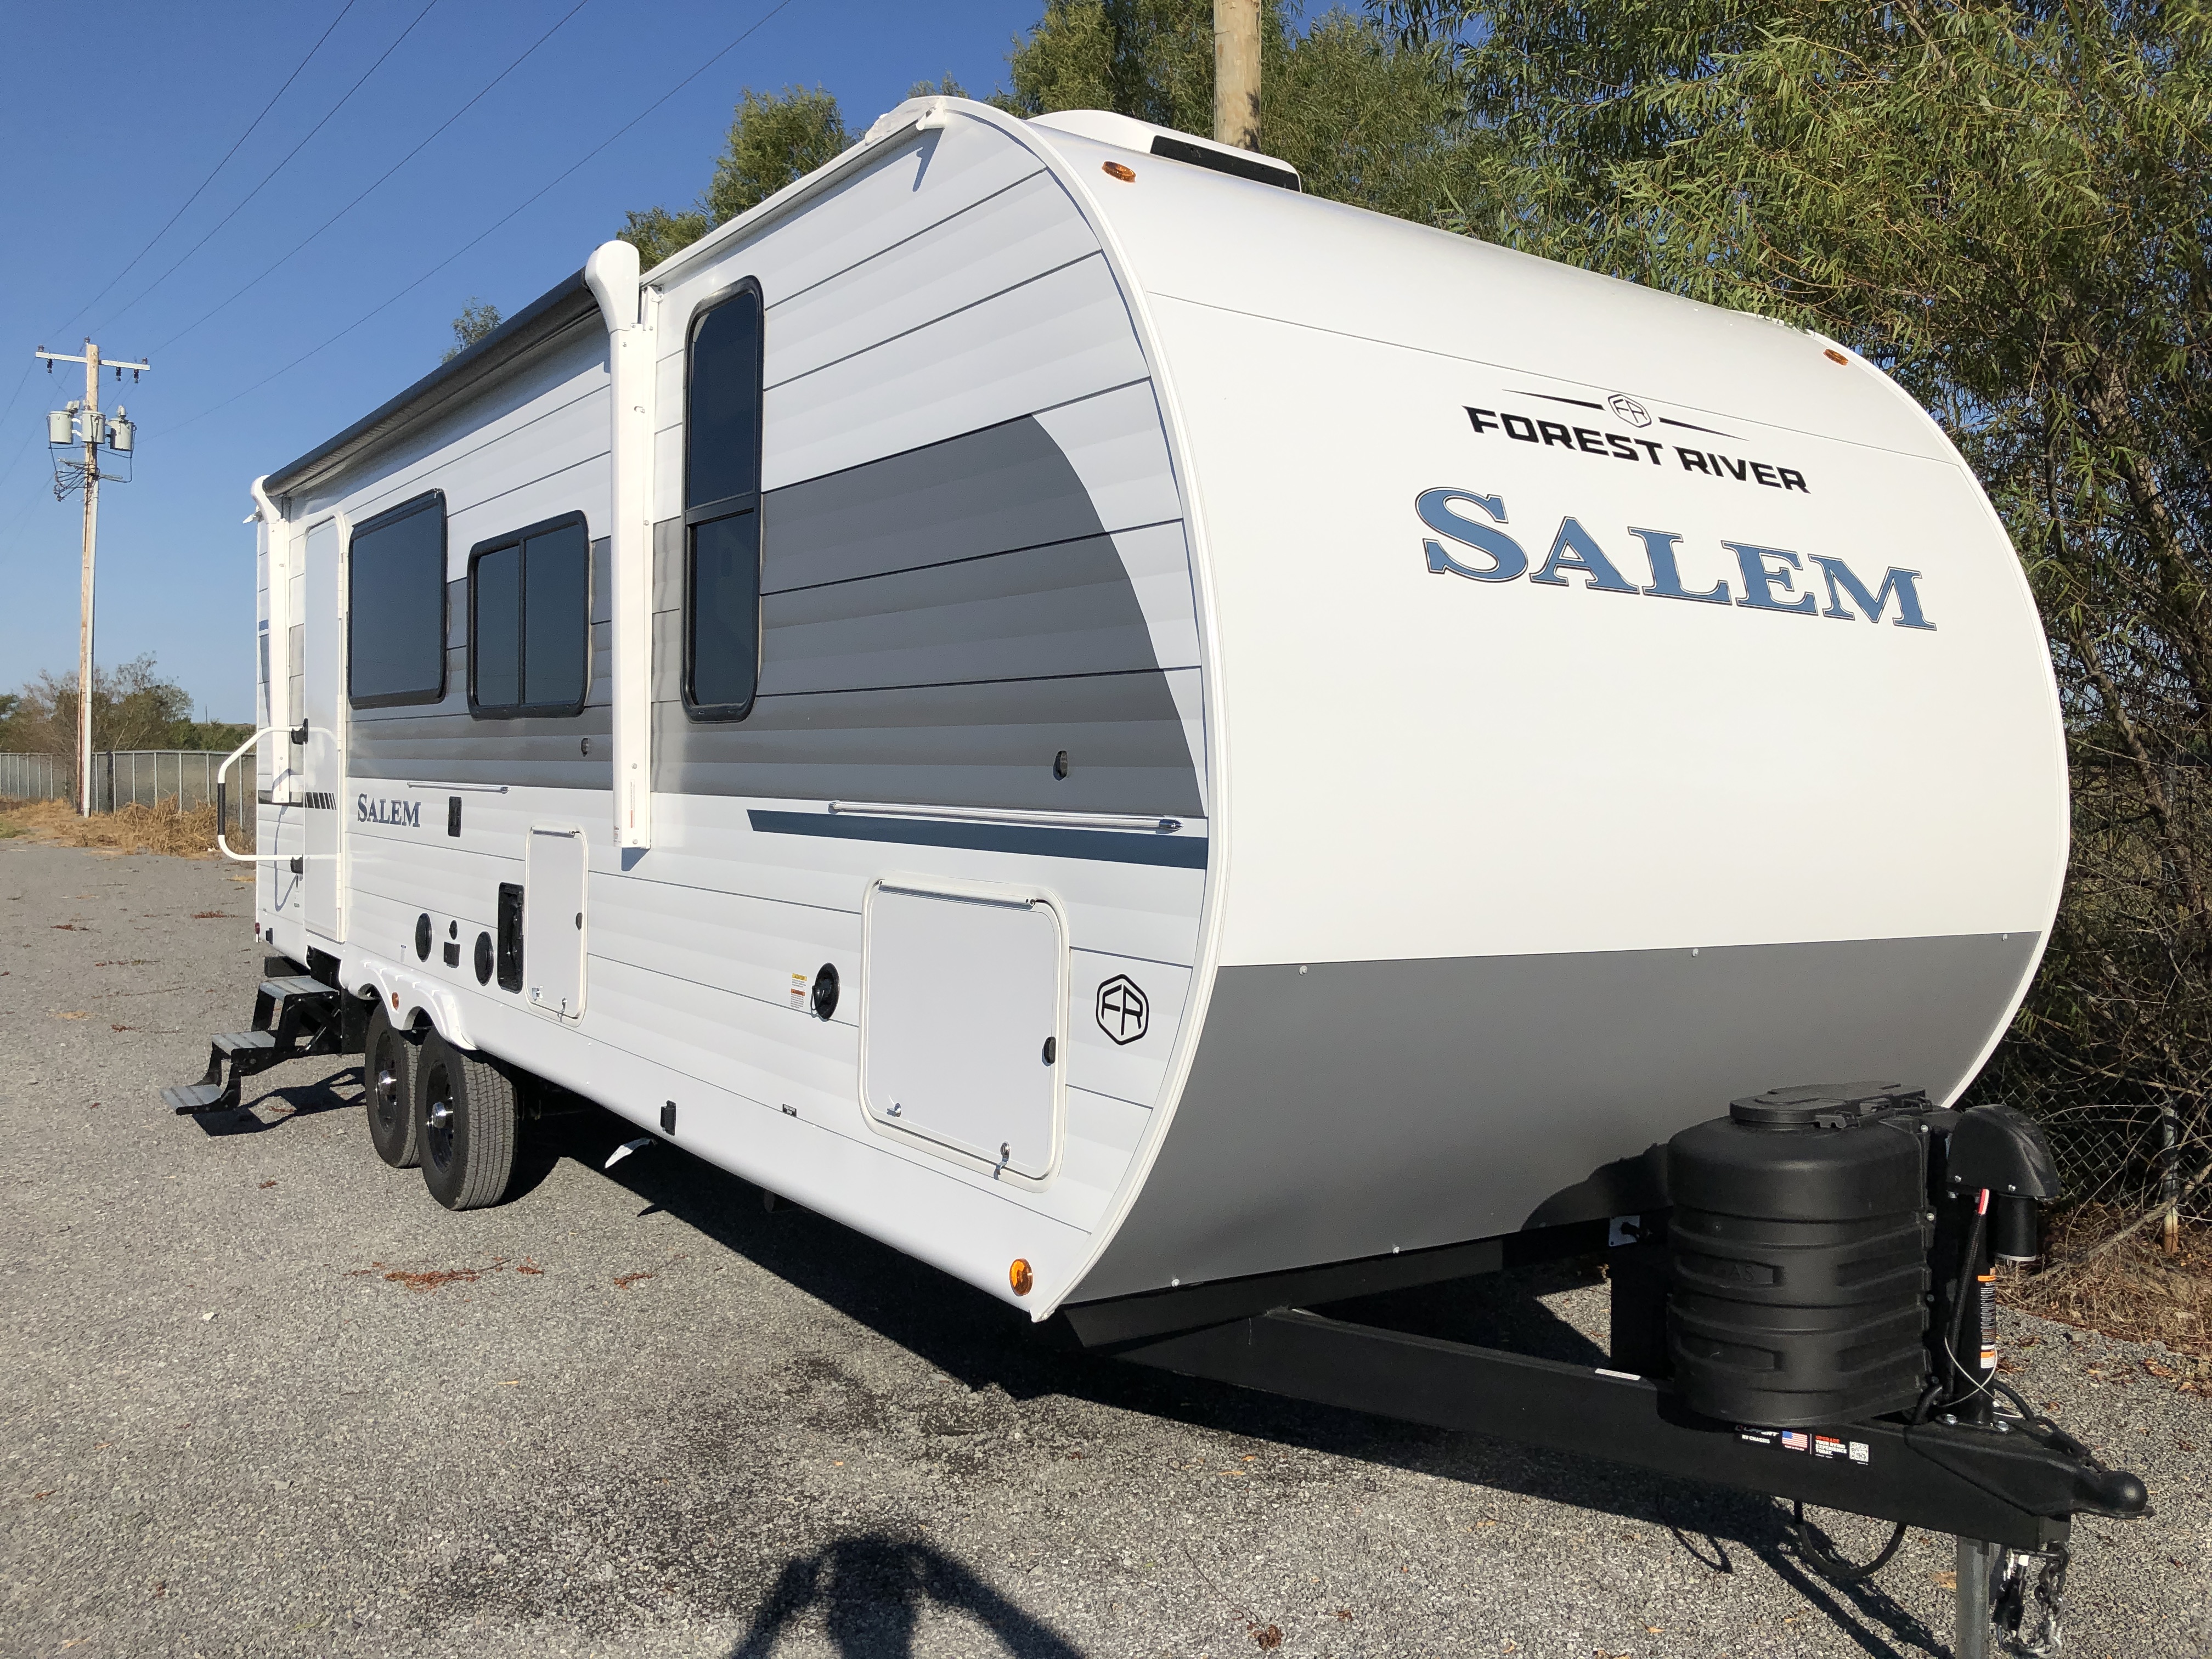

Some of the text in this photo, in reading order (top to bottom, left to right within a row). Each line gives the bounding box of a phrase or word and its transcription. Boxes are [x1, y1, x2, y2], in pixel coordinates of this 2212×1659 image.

[1462, 405, 1811, 494] FOREST RIVER
[1415, 487, 1936, 630] SALEM
[358, 793, 421, 827] SALEM
[1815, 1444, 1847, 1453] EXPERIENCE
